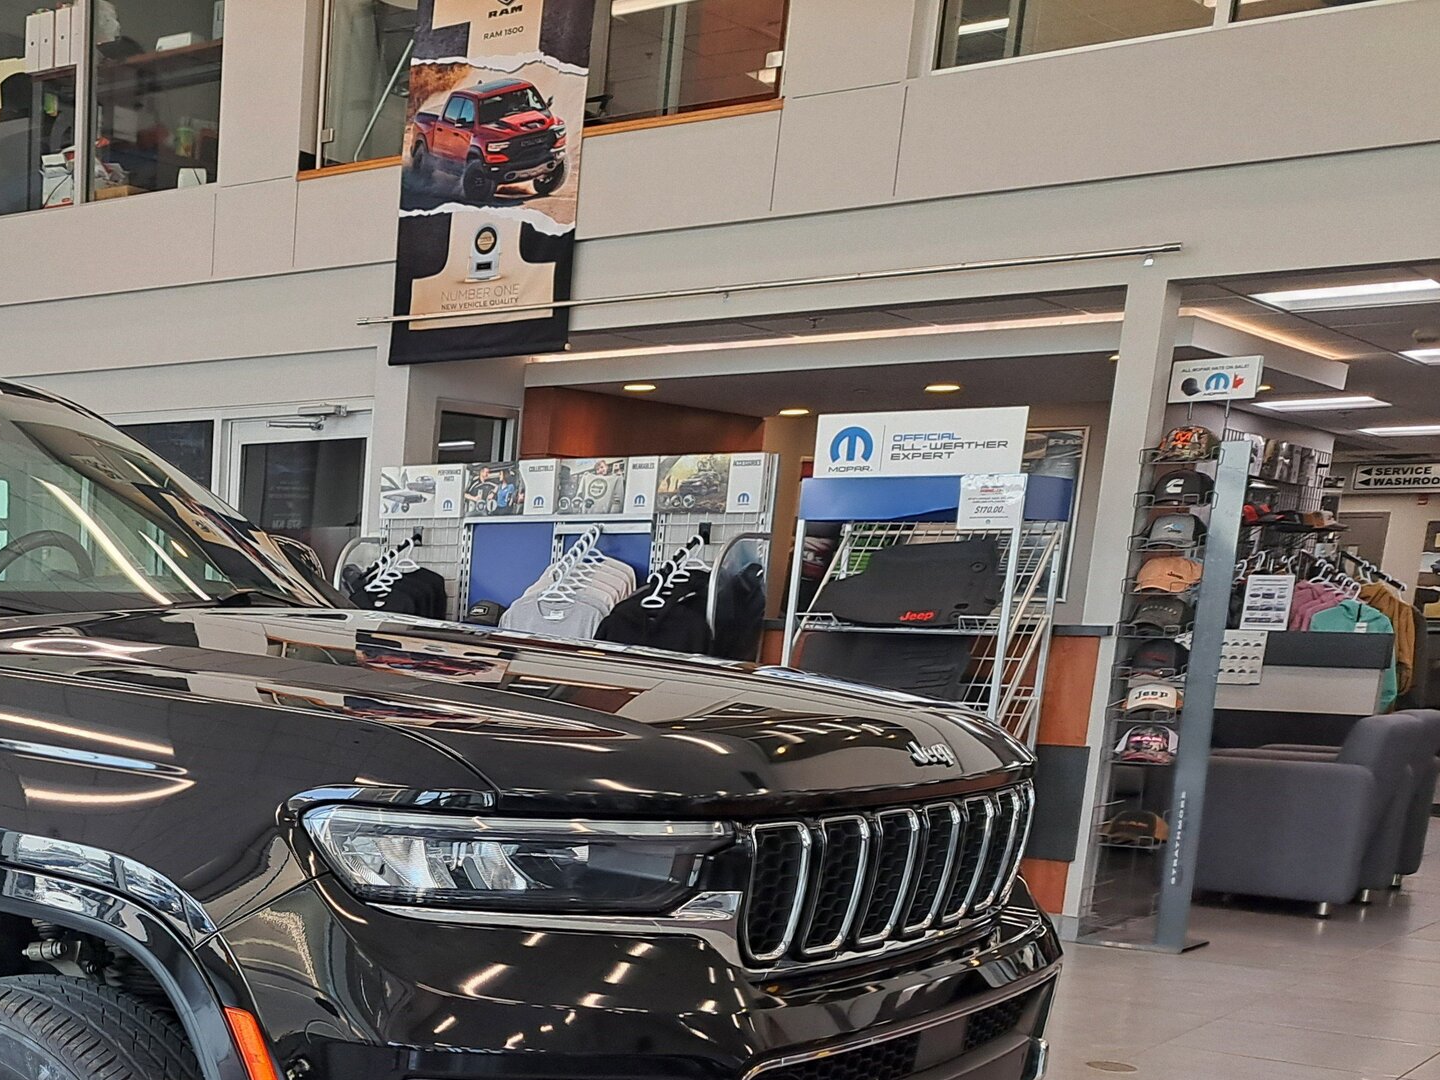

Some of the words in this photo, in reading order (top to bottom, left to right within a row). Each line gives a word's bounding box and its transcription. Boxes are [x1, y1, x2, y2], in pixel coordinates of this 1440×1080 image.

[488, 5, 523, 18] RAM
[483, 30, 503, 40] RAM
[504, 25, 524, 36] 1500
[440, 286, 491, 302] NUMBER
[493, 283, 520, 297] ONE
[458, 299, 488, 309] VEHICLE
[489, 296, 520, 307] QUALITY
[892, 432, 962, 442] OFFICIAL
[890, 440, 1009, 451] ALL-WEATHER
[890, 451, 955, 461] EXPERT
[828, 465, 871, 473] MOPAR
[1375, 466, 1433, 476] SERVICE
[974, 505, 1004, 514] $170.00
[899, 610, 935, 621] Jeep
[906, 741, 954, 765] Jeep
